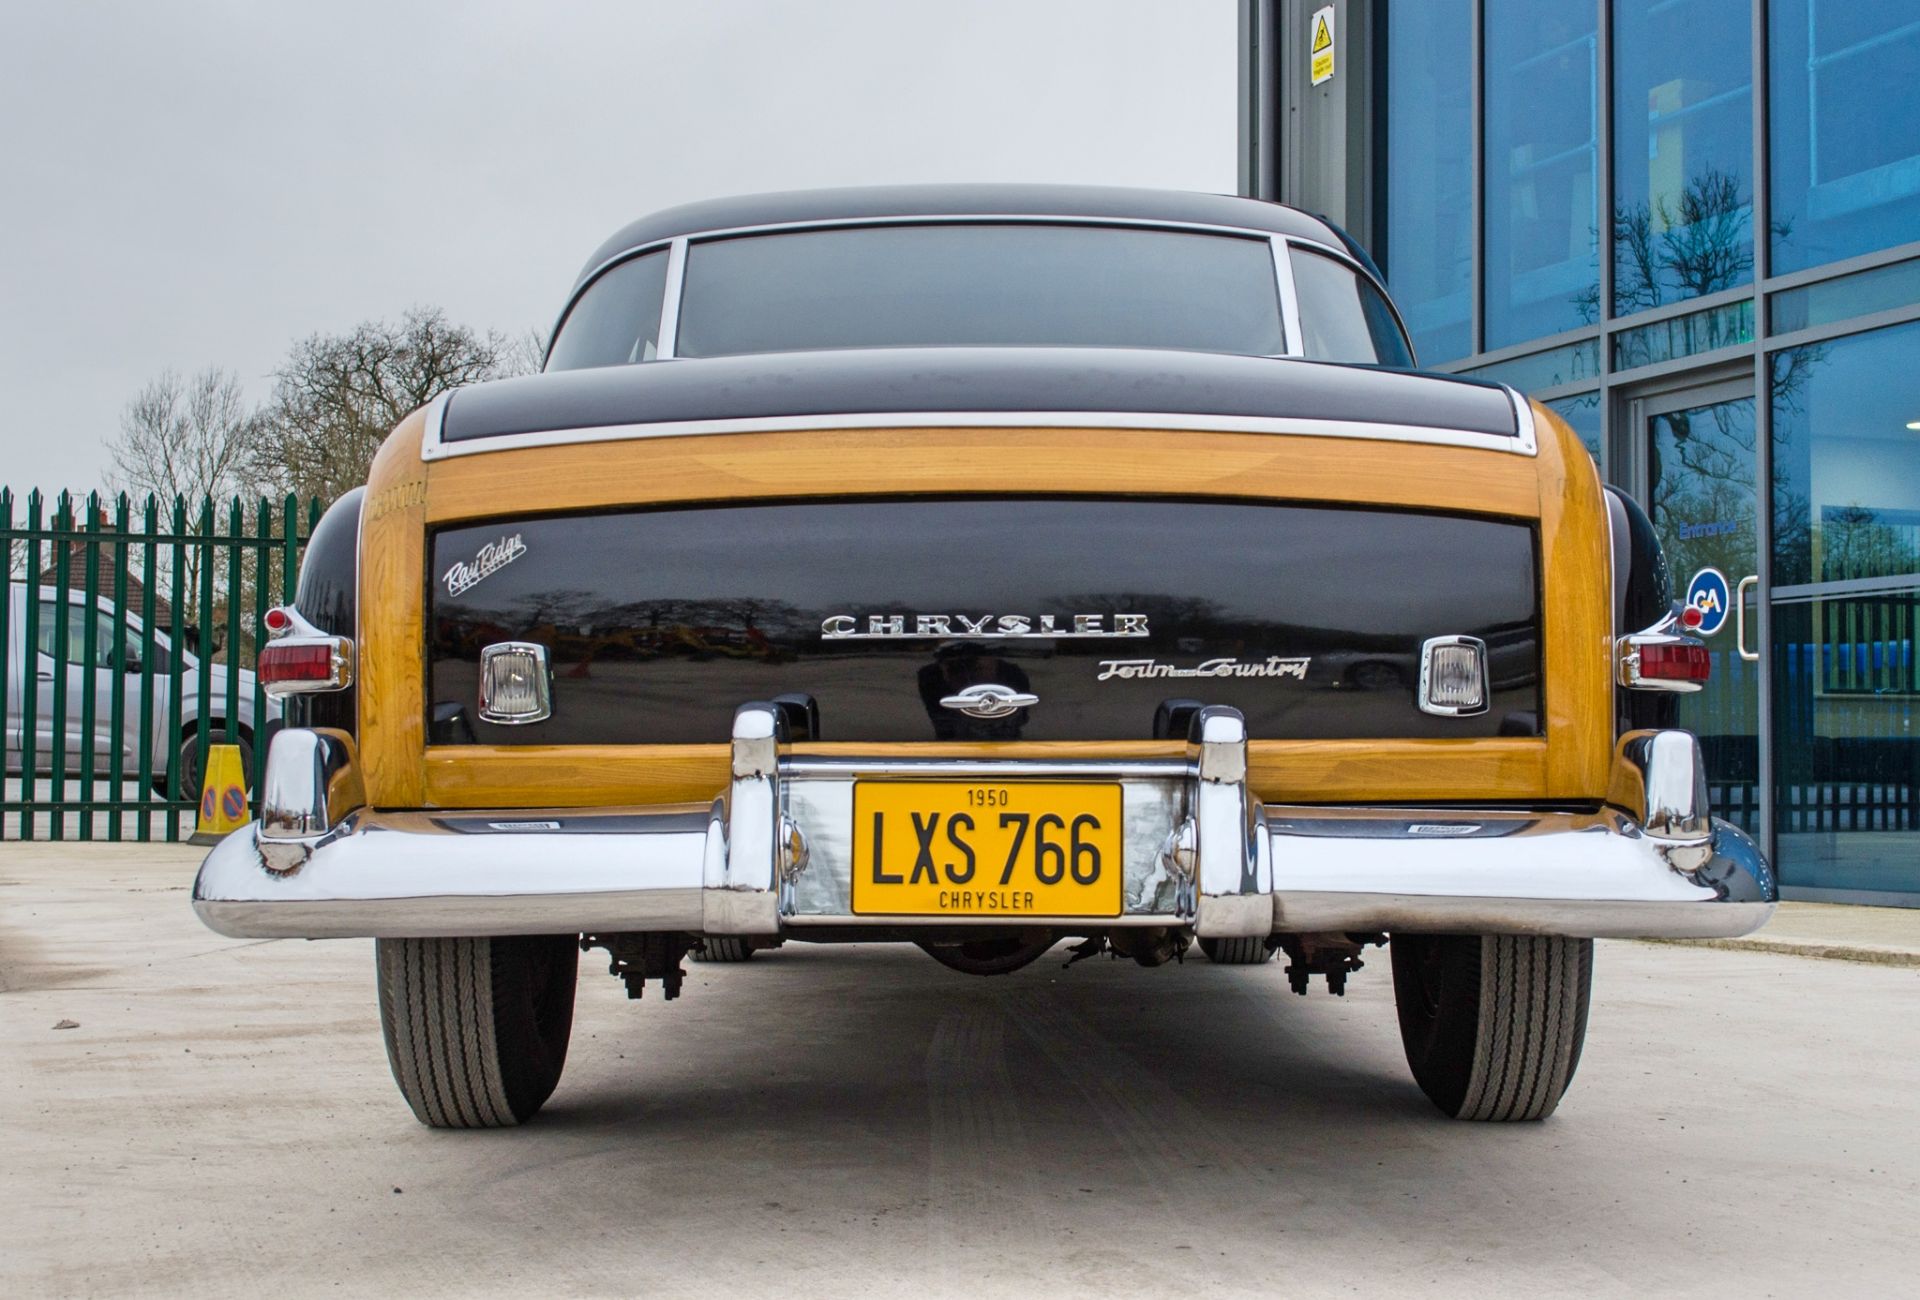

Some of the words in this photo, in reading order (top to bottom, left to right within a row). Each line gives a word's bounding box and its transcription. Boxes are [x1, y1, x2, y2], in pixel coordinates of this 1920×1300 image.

[1679, 519, 1737, 540] Entrance
[442, 559, 480, 591] Ray
[476, 533, 522, 570] Ridge
[821, 614, 1150, 635] CHRYSLER
[1097, 659, 1174, 681] Town
[1196, 656, 1312, 680] Country
[967, 789, 1009, 807] 1950
[872, 812, 976, 886] LXS
[999, 812, 1102, 886] 766
[939, 891, 1034, 909] CHRYSLER
